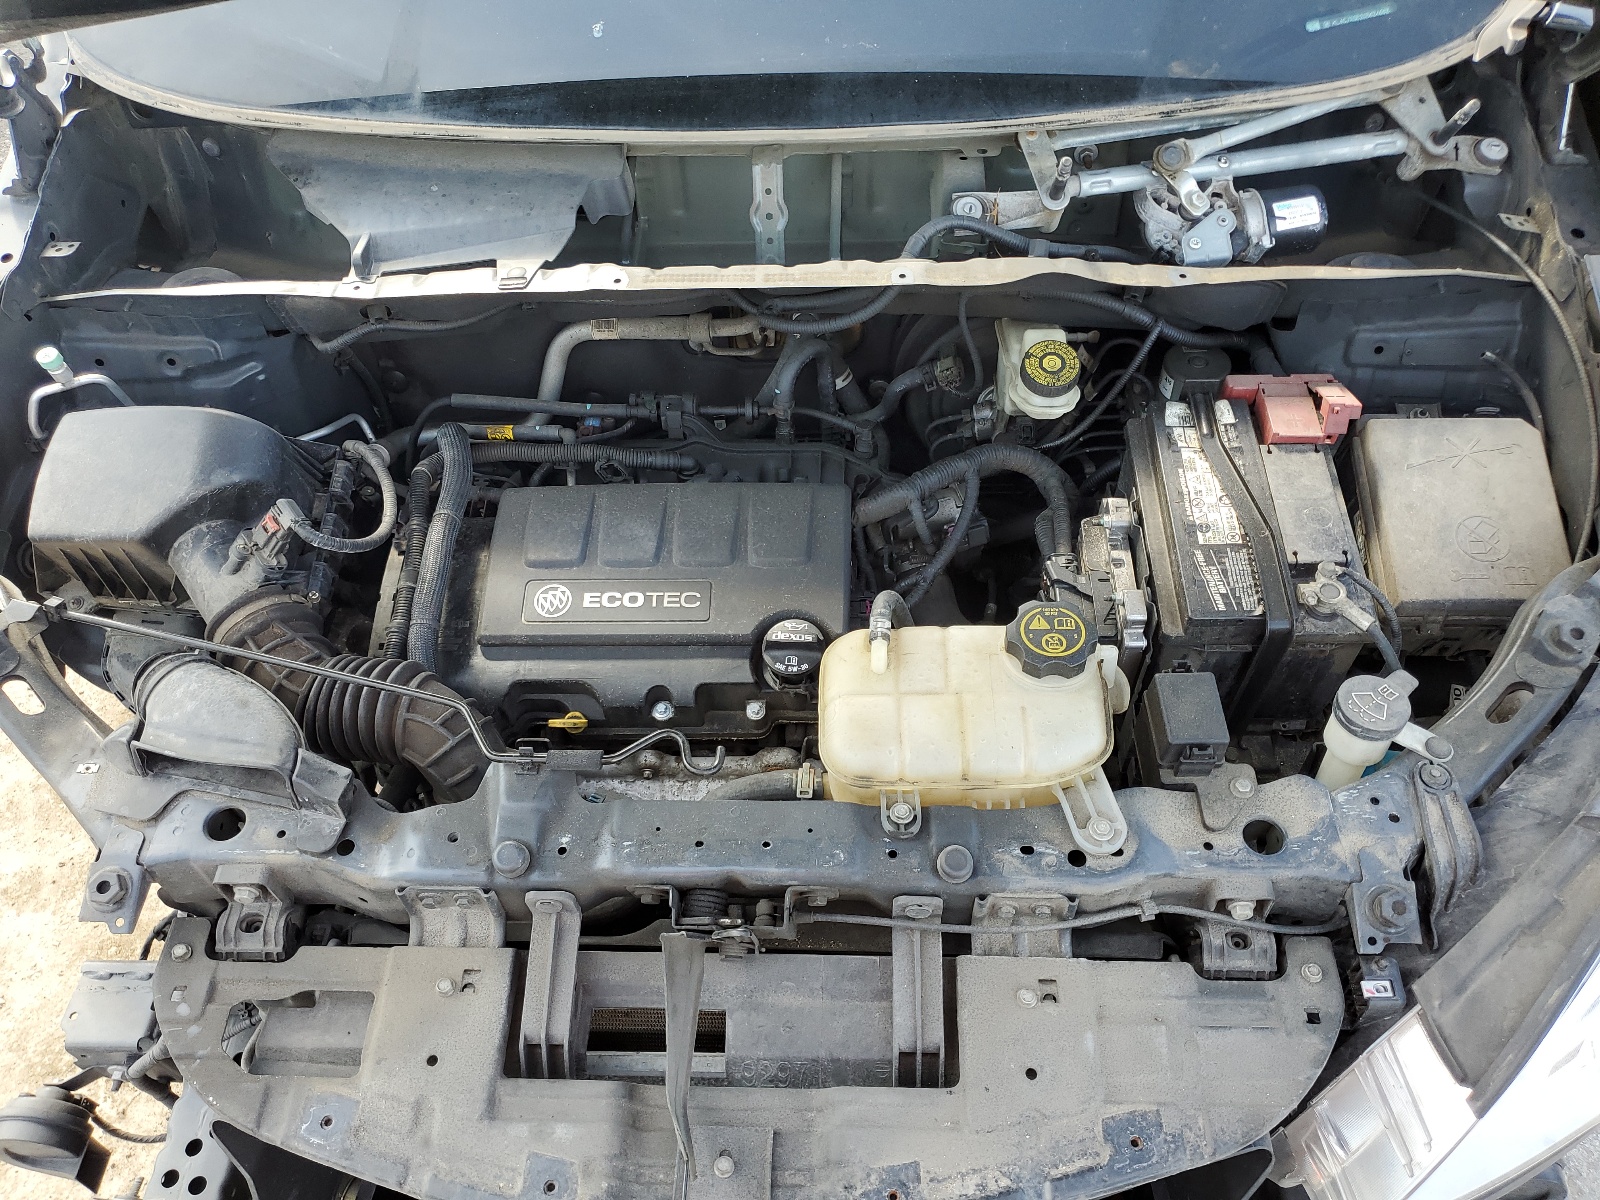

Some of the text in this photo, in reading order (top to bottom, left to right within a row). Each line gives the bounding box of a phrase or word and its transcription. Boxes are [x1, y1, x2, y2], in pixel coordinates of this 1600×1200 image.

[1194, 549, 1226, 611] MAINTENANCE-FREE
[1208, 565, 1228, 594] BATTERY
[582, 591, 701, 608] ECOTEC
[772, 631, 813, 642] dexos
[774, 662, 787, 671] SAE
